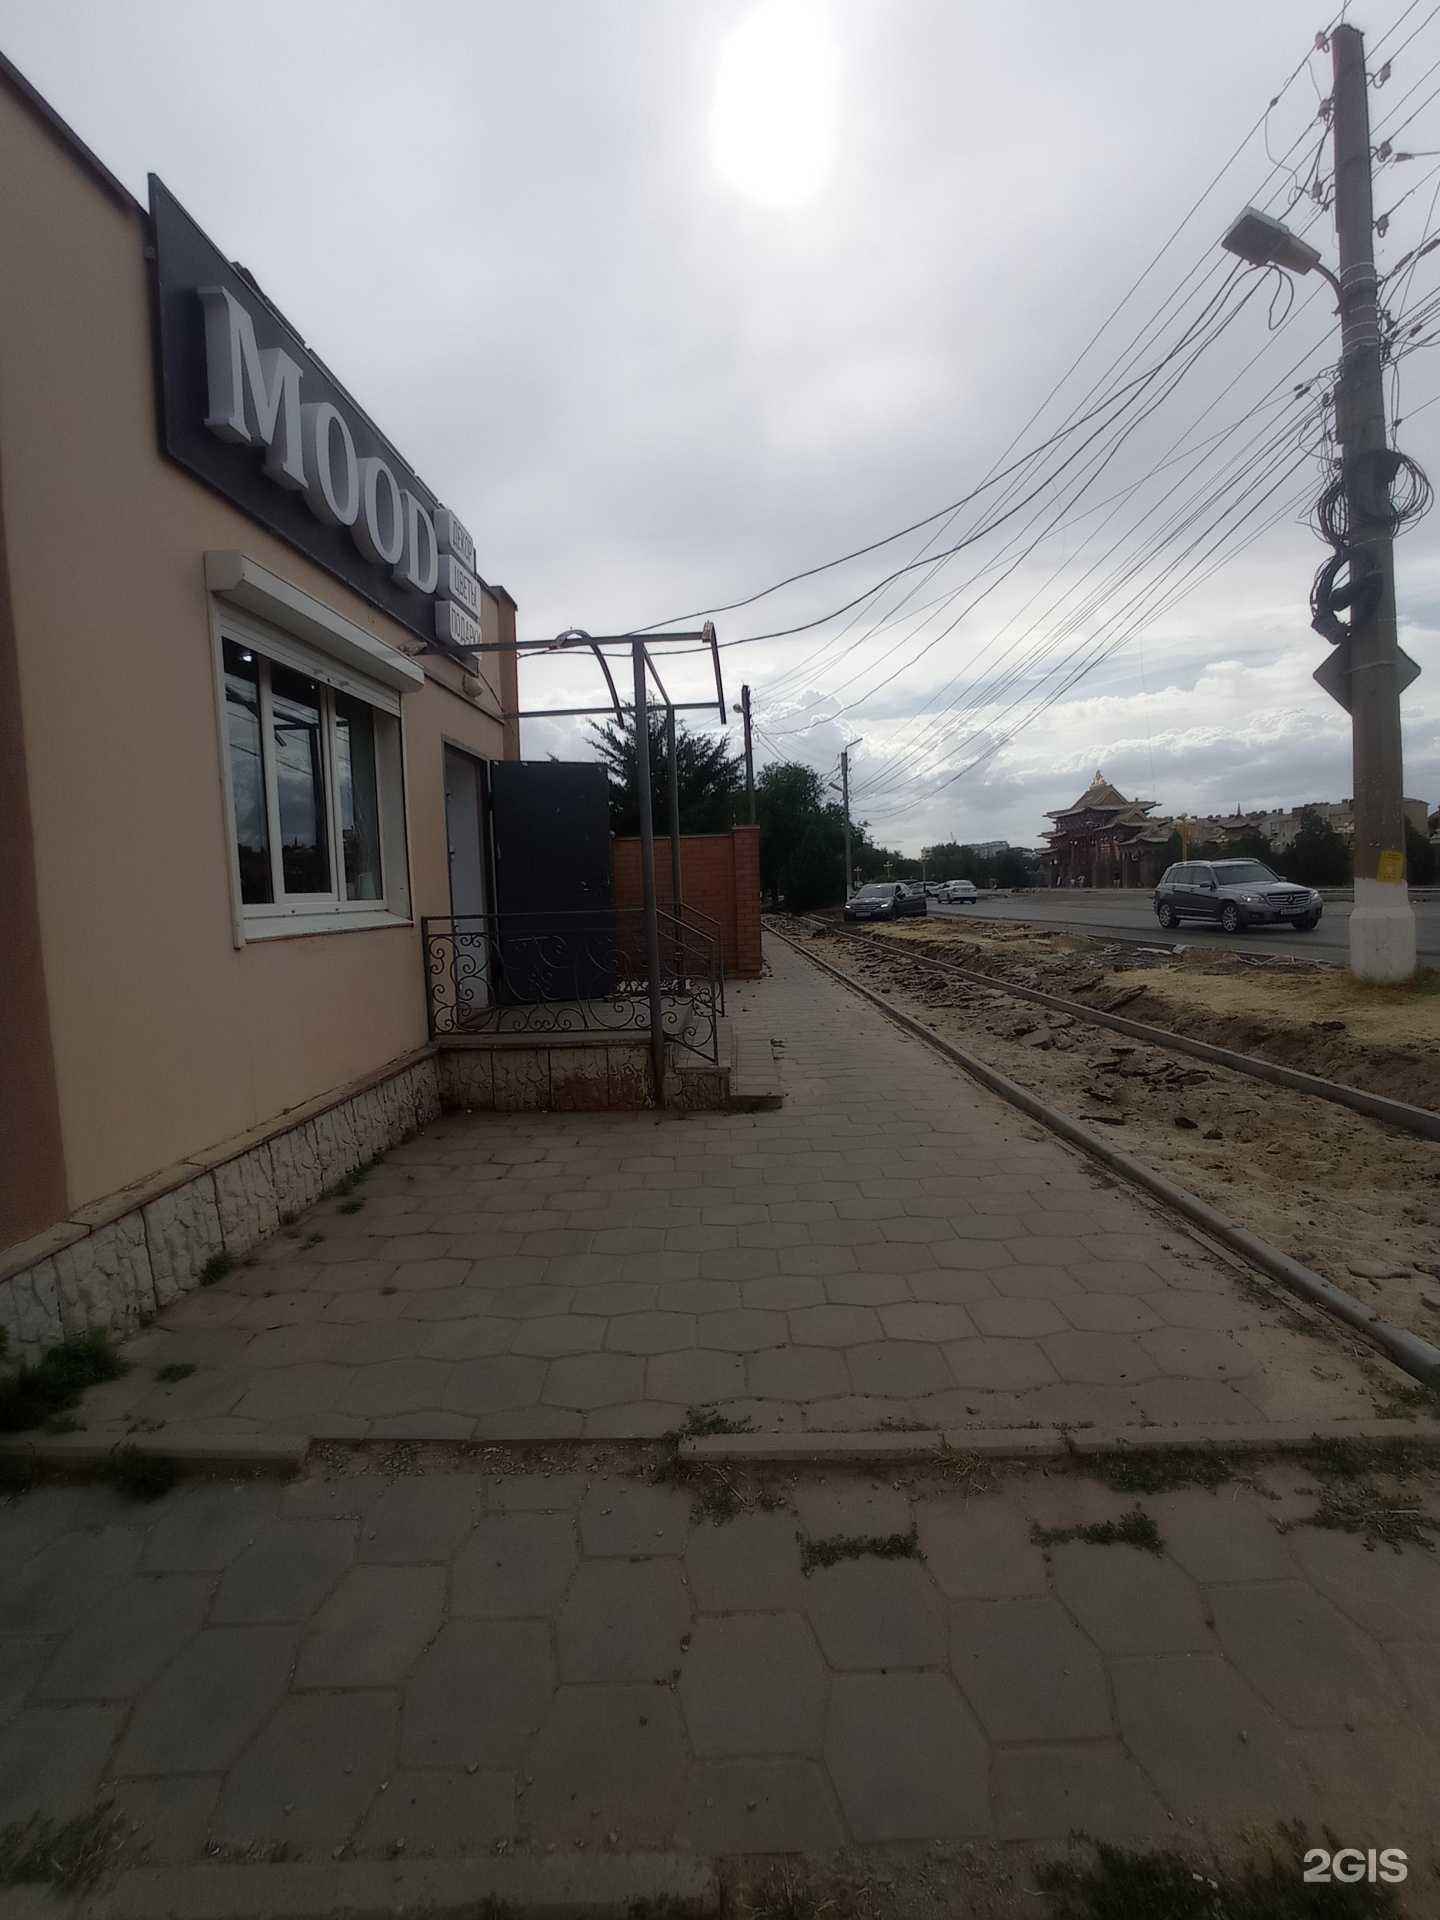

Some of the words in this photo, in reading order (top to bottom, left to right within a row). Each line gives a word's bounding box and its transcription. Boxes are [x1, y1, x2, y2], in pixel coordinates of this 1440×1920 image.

[198, 286, 438, 594] MOOD
[452, 520, 473, 561] ДЕКОР
[454, 565, 477, 608] ЦВЕТЫ
